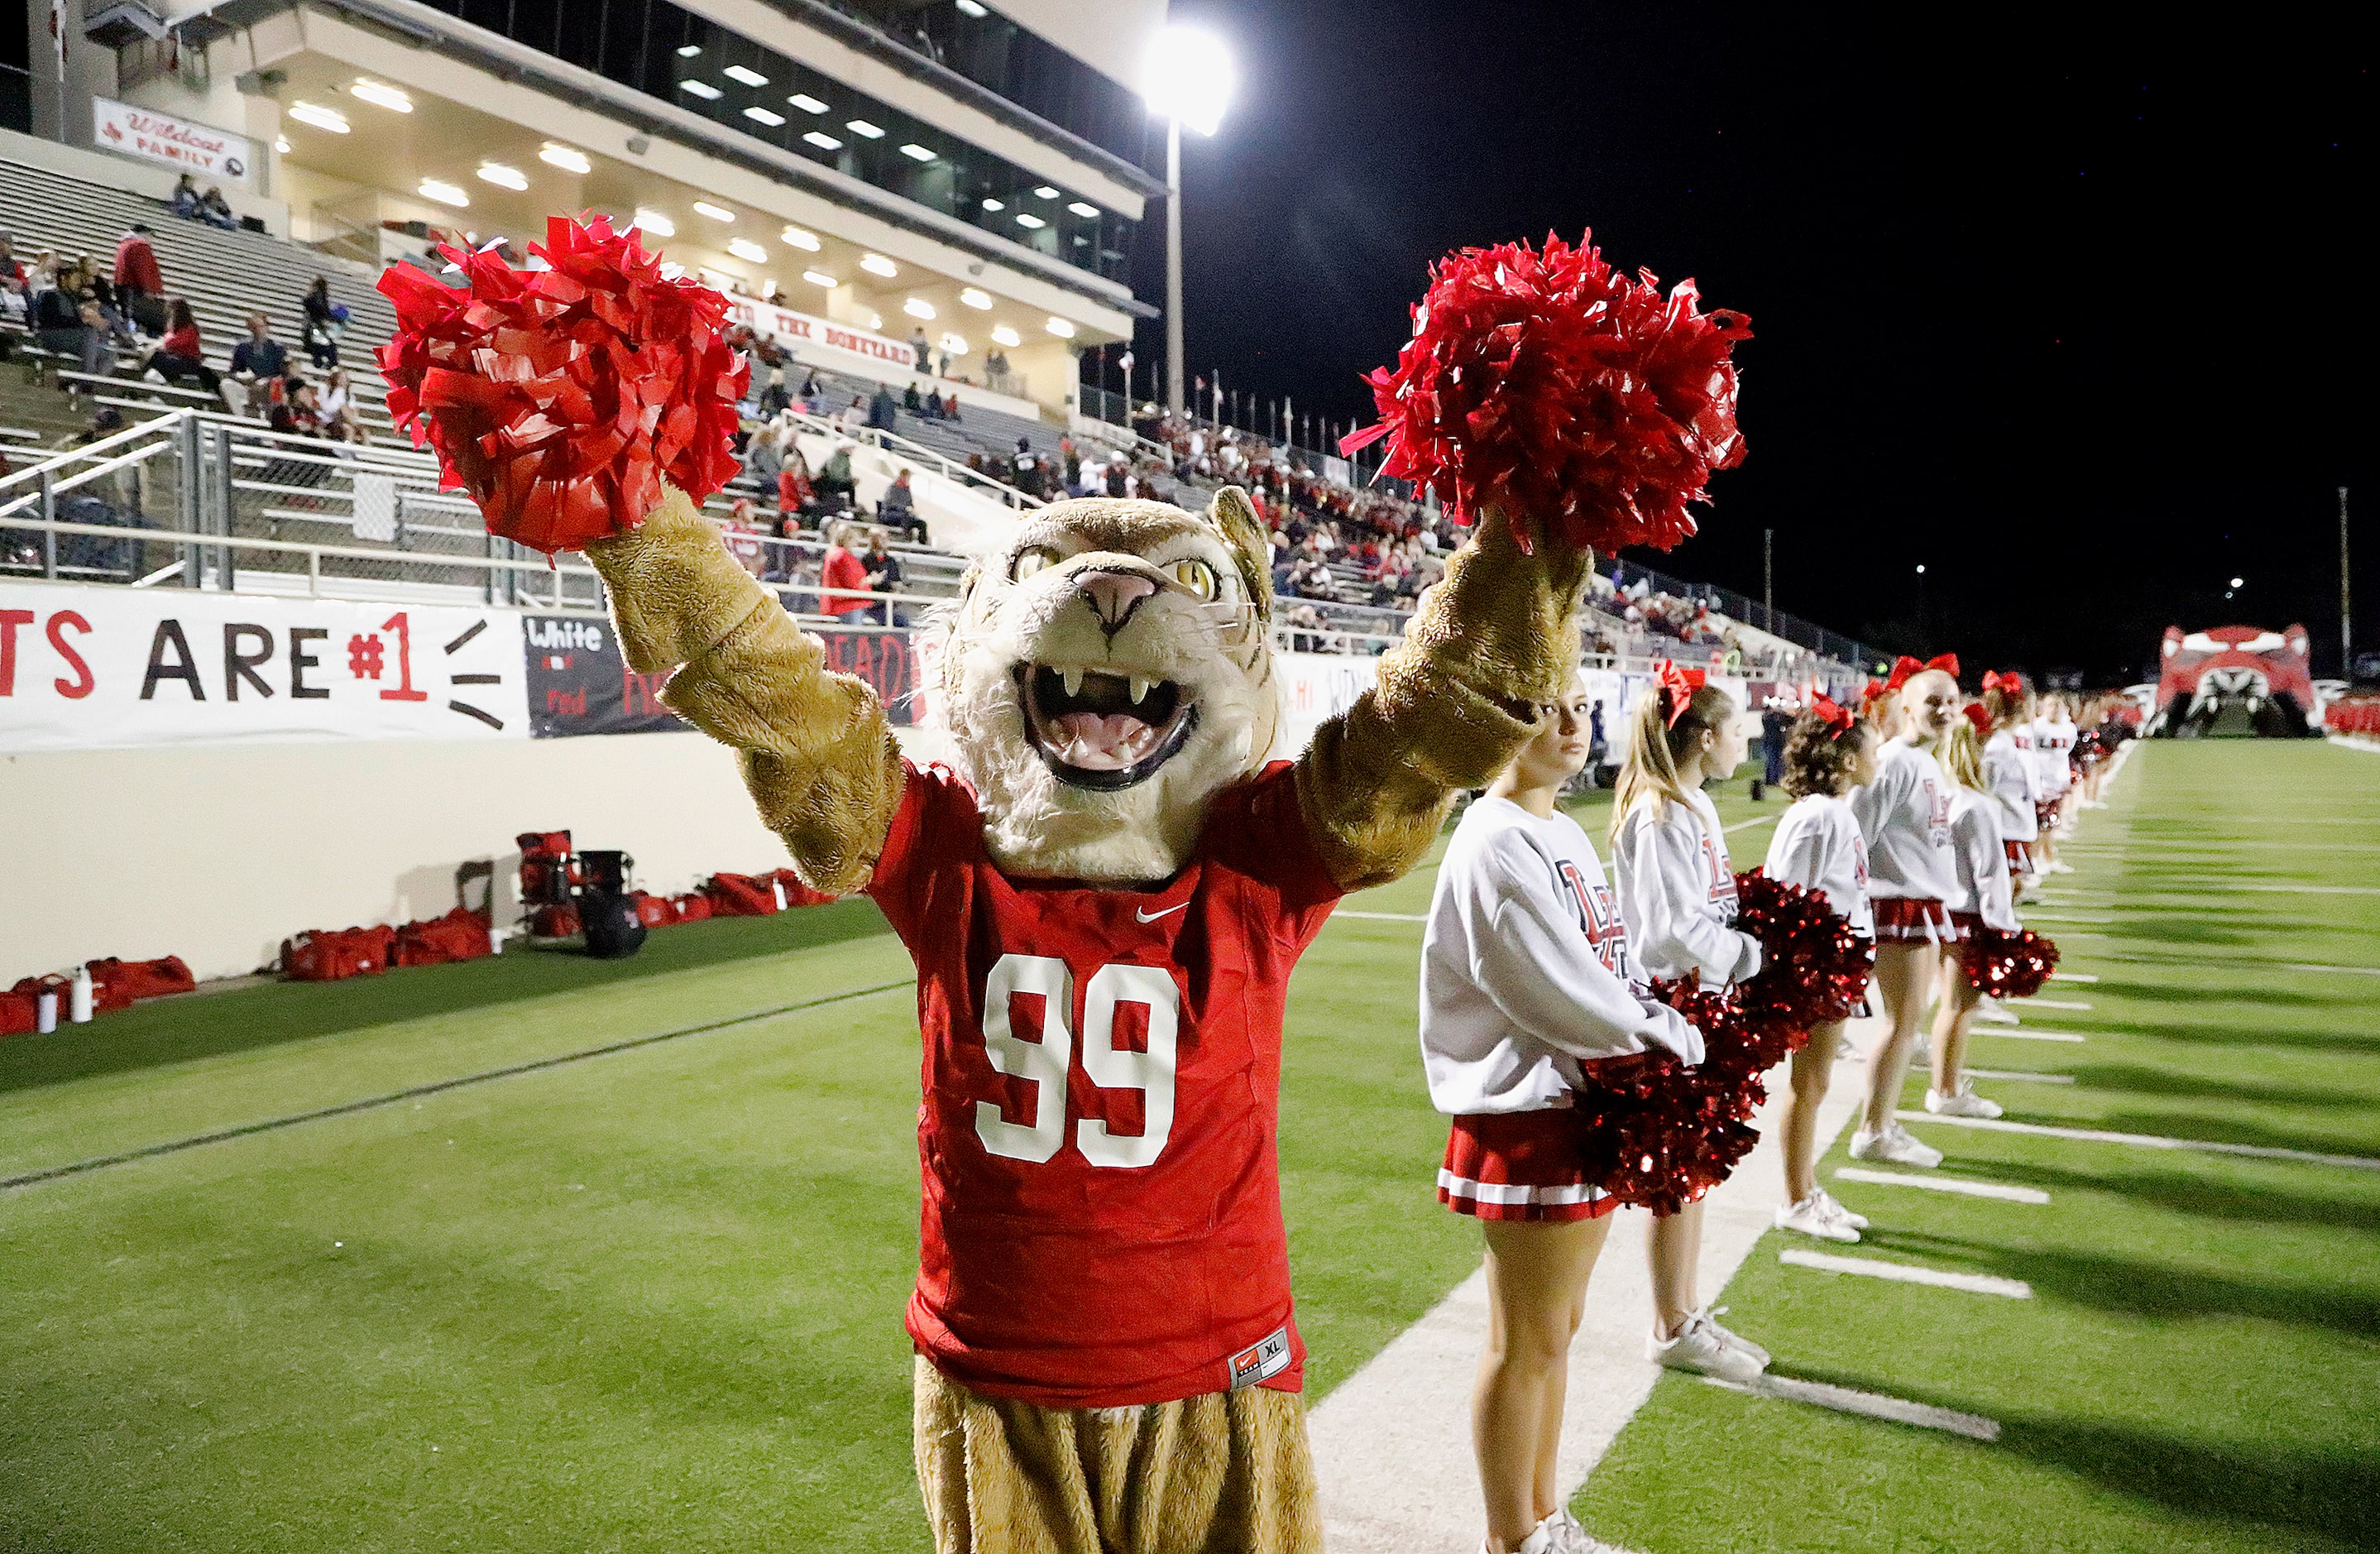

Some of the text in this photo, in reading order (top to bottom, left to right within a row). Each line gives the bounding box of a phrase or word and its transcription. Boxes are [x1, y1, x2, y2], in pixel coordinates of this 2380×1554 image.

[126, 113, 225, 153] Wildcat
[136, 137, 213, 168] FAMILY
[776, 314, 812, 338] THE
[826, 326, 912, 367] BONEYARD
[526, 617, 603, 652] White
[140, 618, 330, 702] ARE
[347, 612, 428, 702] #1
[975, 953, 1180, 1168] 99
[1265, 1341, 1280, 1357] XL
[1240, 1362, 1259, 1376] TEAM
